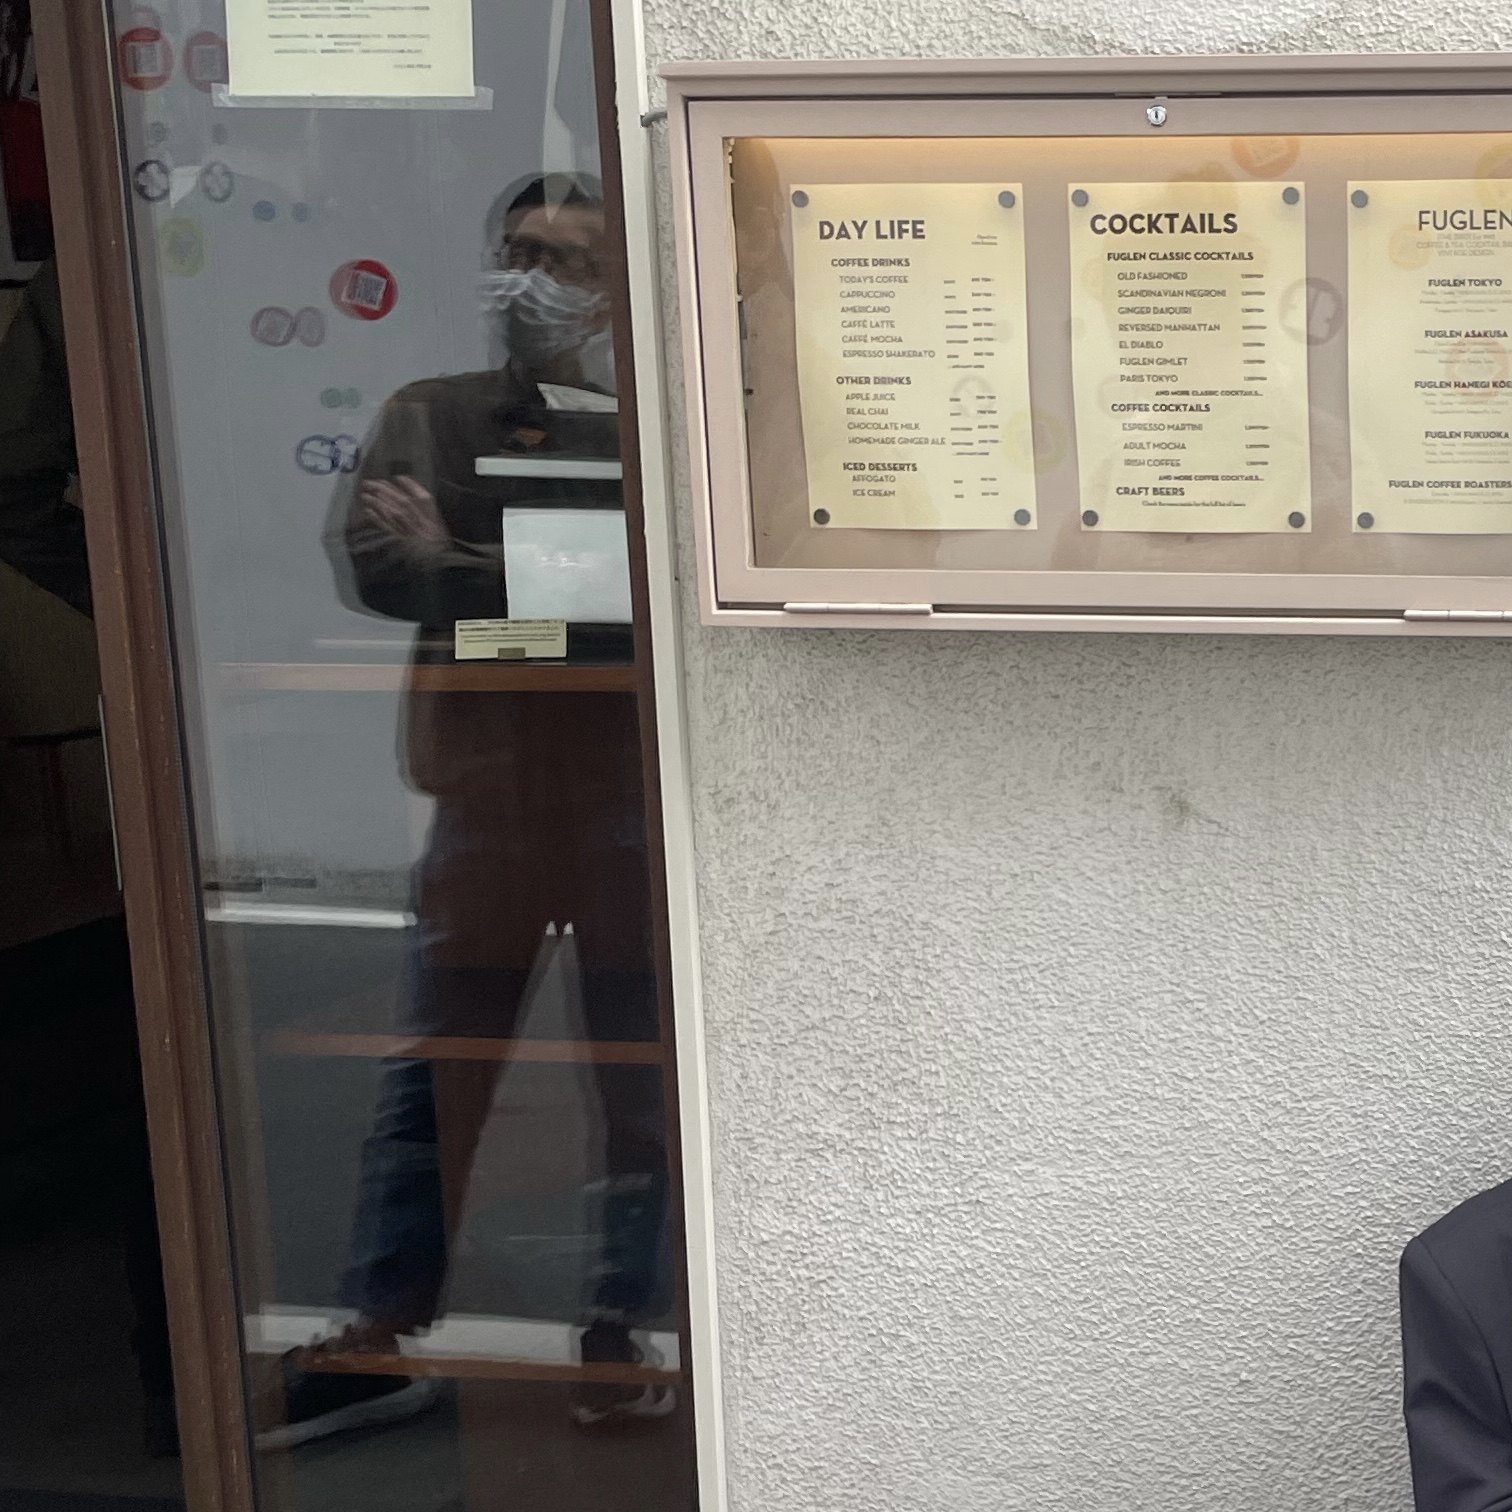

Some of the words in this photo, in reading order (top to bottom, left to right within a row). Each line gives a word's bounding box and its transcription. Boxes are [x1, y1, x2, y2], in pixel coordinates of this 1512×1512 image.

[1090, 213, 1238, 235] COCKTAILS
[819, 220, 868, 240] DAY
[875, 220, 925, 239] LIFE
[1107, 253, 1146, 261] FUGLEN
[1149, 252, 1192, 261] CLASSIC
[1194, 252, 1253, 261] COCKTAILS
[831, 259, 870, 267] COFFEE
[872, 258, 910, 267] DRINKS
[1117, 272, 1136, 280] OLD
[1137, 272, 1187, 280] FASHIONED
[1428, 279, 1465, 287] FUGLEN
[1468, 279, 1502, 287] TOKYO
[1117, 289, 1184, 298] SCANDINAVIAN
[1185, 289, 1226, 297] NEGRONI
[1118, 307, 1151, 315] GINGER
[1152, 307, 1192, 315] DAIQUIRI
[1119, 324, 1162, 332] REVERSED
[1164, 324, 1220, 332] MANHATTAN
[1425, 330, 1461, 338] FUGLEN
[1464, 330, 1508, 338] ASAKUSA
[1131, 341, 1163, 349] DIABLO
[843, 350, 883, 358] ESPRESSO
[886, 350, 935, 358] SHAKERATO
[1120, 358, 1154, 366] FUGLEN
[836, 376, 871, 385] OTHER
[873, 376, 911, 385] DRINKS
[846, 393, 870, 401] APPLE
[872, 393, 895, 401] JUICE
[1111, 404, 1150, 412] COFFEE
[1152, 404, 1210, 412] COCKTAILS
[847, 422, 899, 430] CHOCOLATE
[1122, 423, 1165, 431] ESPRESSO
[1167, 423, 1203, 431] MARTINI
[848, 437, 896, 445] HOMEMADE
[897, 437, 929, 445] GINGER
[1123, 442, 1151, 450] ADULT
[1153, 442, 1186, 450] MOCHA
[843, 463, 865, 471] ICED
[869, 463, 917, 471] DESSERTS
[1124, 459, 1145, 467] IRISH
[1147, 459, 1181, 467] COFFEE
[1389, 480, 1424, 488] FUGLEN
[1116, 487, 1149, 496] CRAFT
[1153, 488, 1185, 496] BEERS
